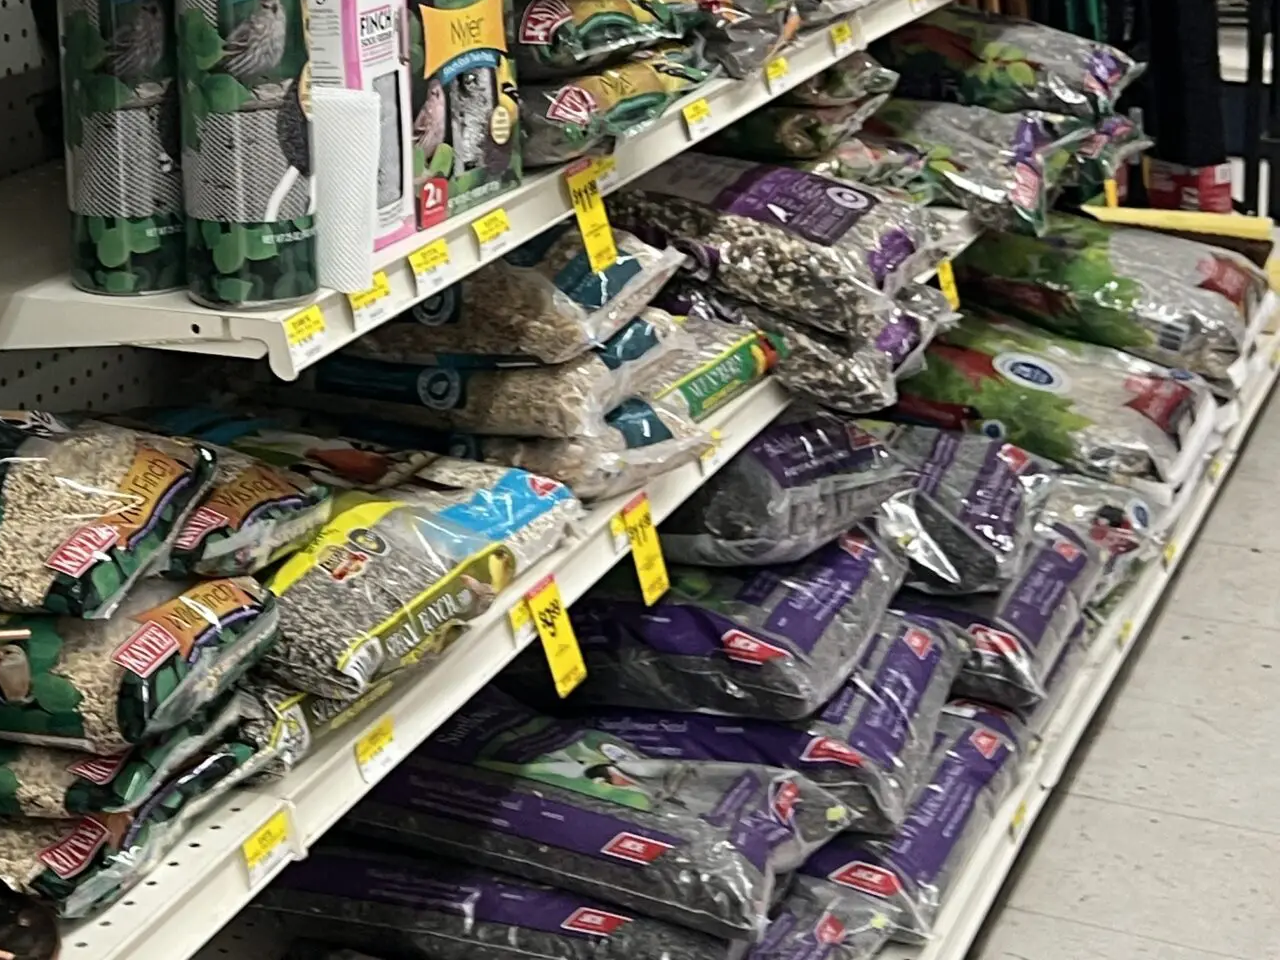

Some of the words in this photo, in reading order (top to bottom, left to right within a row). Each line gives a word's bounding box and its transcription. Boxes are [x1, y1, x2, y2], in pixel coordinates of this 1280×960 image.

[360, 9, 393, 36] FINCH
[140, 458, 170, 493] Finch
[119, 630, 174, 674] KAYTEE
